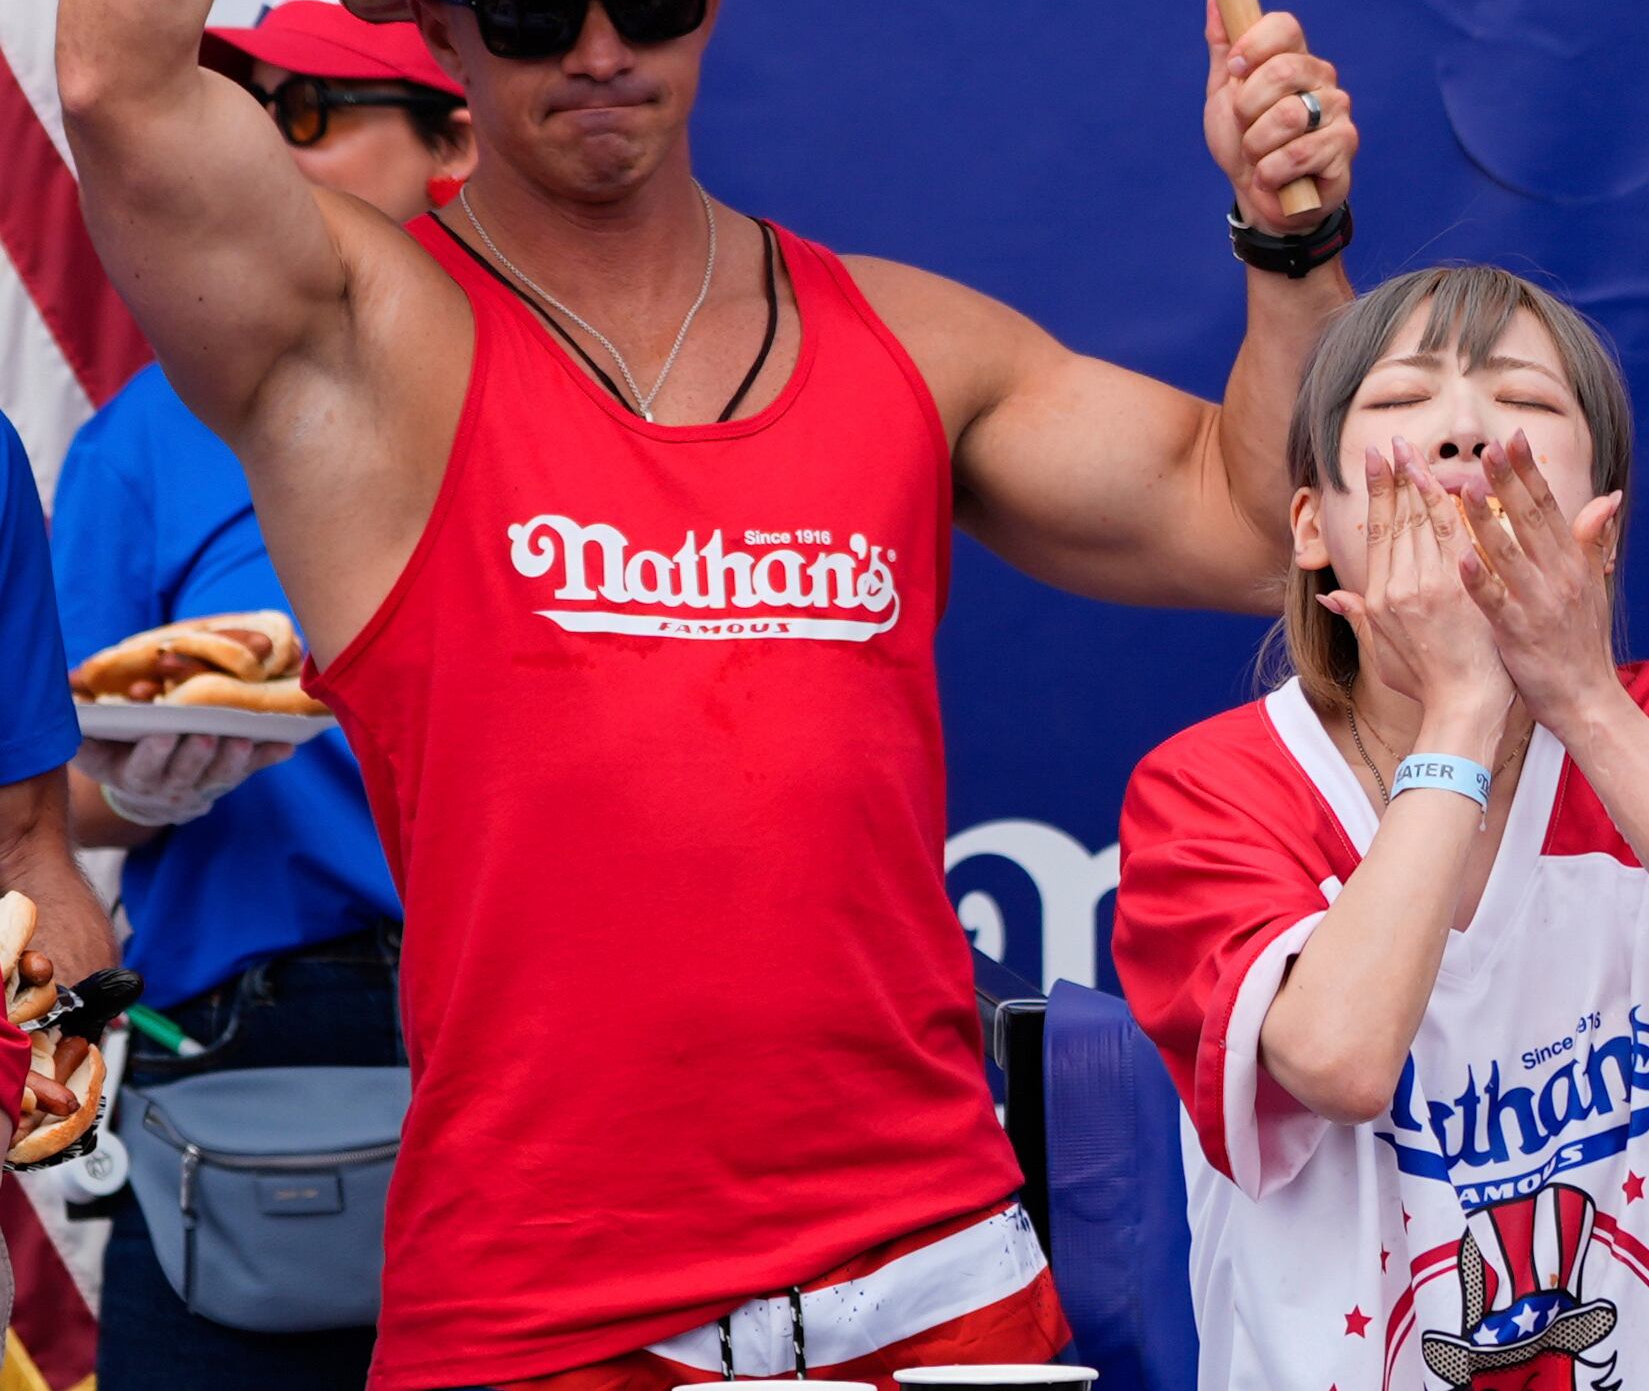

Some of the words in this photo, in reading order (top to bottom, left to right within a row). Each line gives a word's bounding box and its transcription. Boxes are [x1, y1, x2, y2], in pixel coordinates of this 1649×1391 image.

[507, 514, 894, 612] Nathan's
[744, 530, 791, 545] Since
[795, 530, 831, 545] 1916
[658, 621, 791, 634] FAMOUS
[1521, 1035, 1574, 1070] Since
[1576, 1010, 1601, 1034] 916
[1457, 1143, 1584, 1206] AMOS
